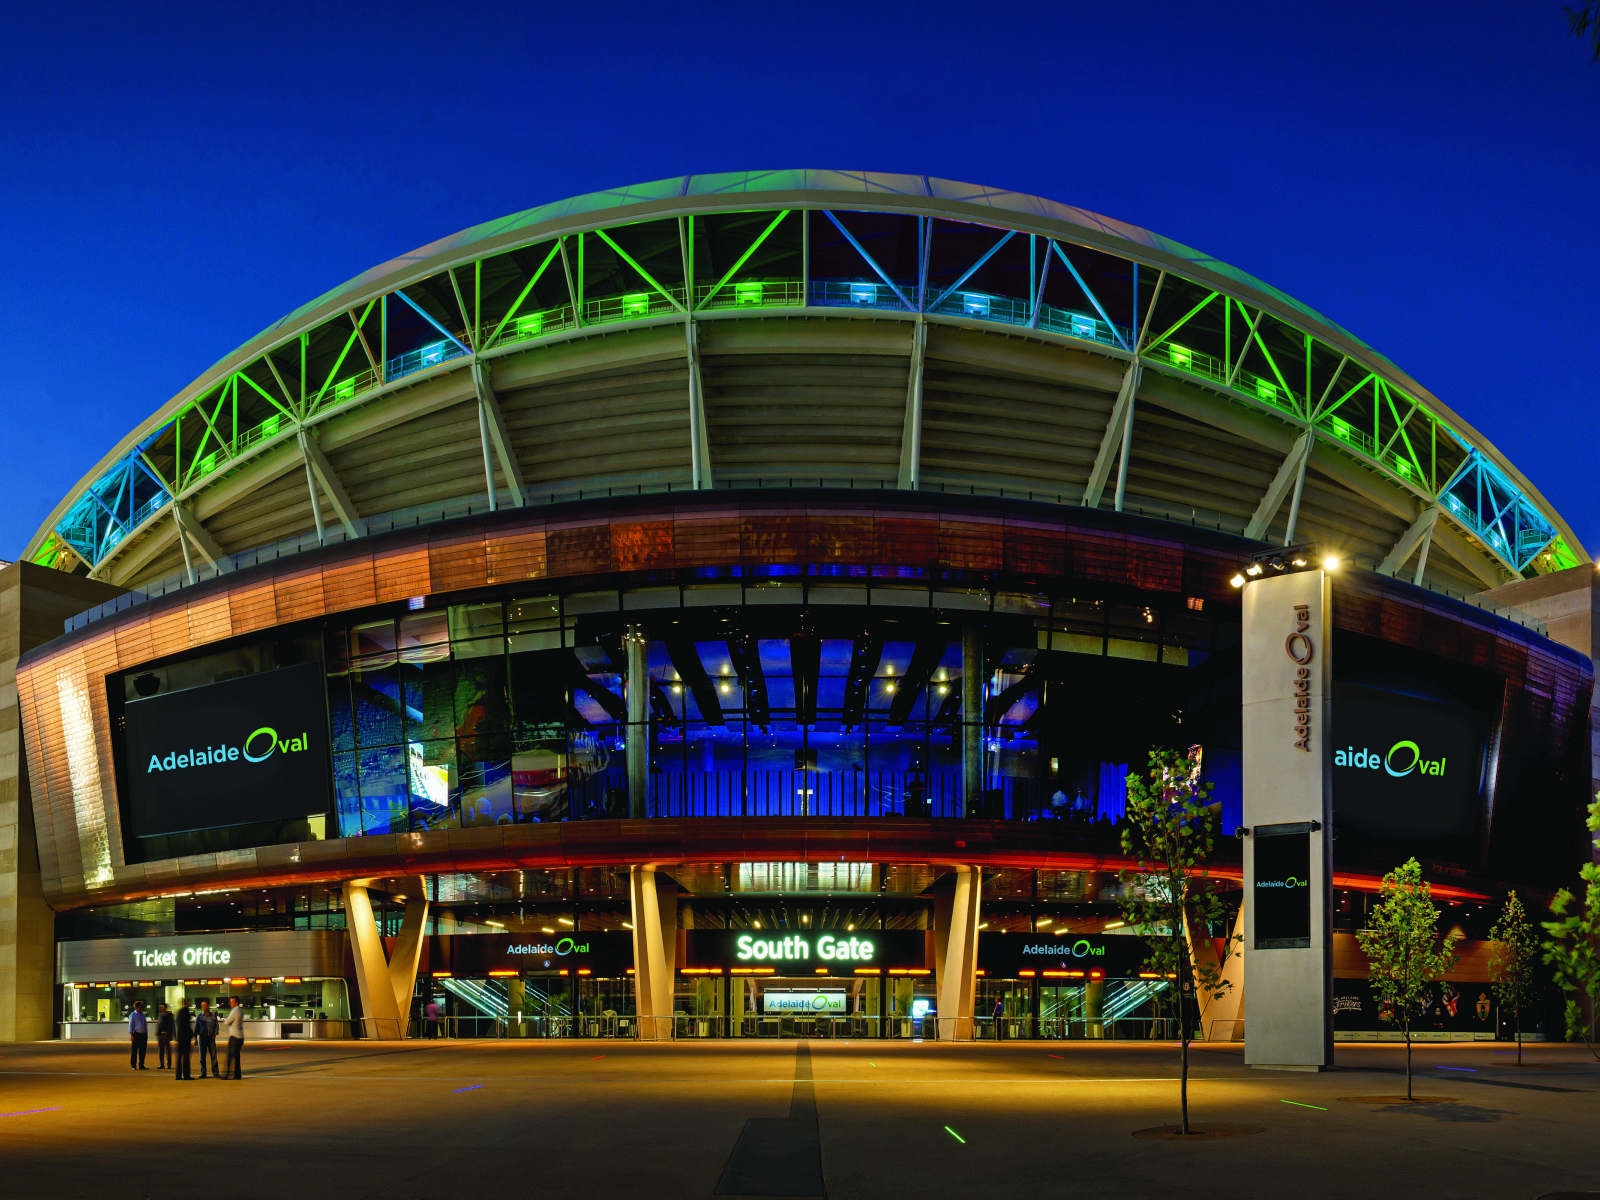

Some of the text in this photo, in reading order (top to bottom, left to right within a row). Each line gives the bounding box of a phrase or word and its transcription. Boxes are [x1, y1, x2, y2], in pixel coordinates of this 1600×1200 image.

[1285, 604, 1312, 752] Adelaide Oval
[147, 727, 308, 773] Adelaide Oval
[1384, 740, 1446, 777] Oval
[1256, 877, 1307, 889] Adelaide Oval
[133, 947, 231, 967] Ticket Office
[507, 938, 589, 956] Adelaide Oval
[737, 935, 874, 960] South Gate
[1023, 940, 1105, 957] Adelaide Oval
[769, 995, 841, 1010] Adelaide Oval
